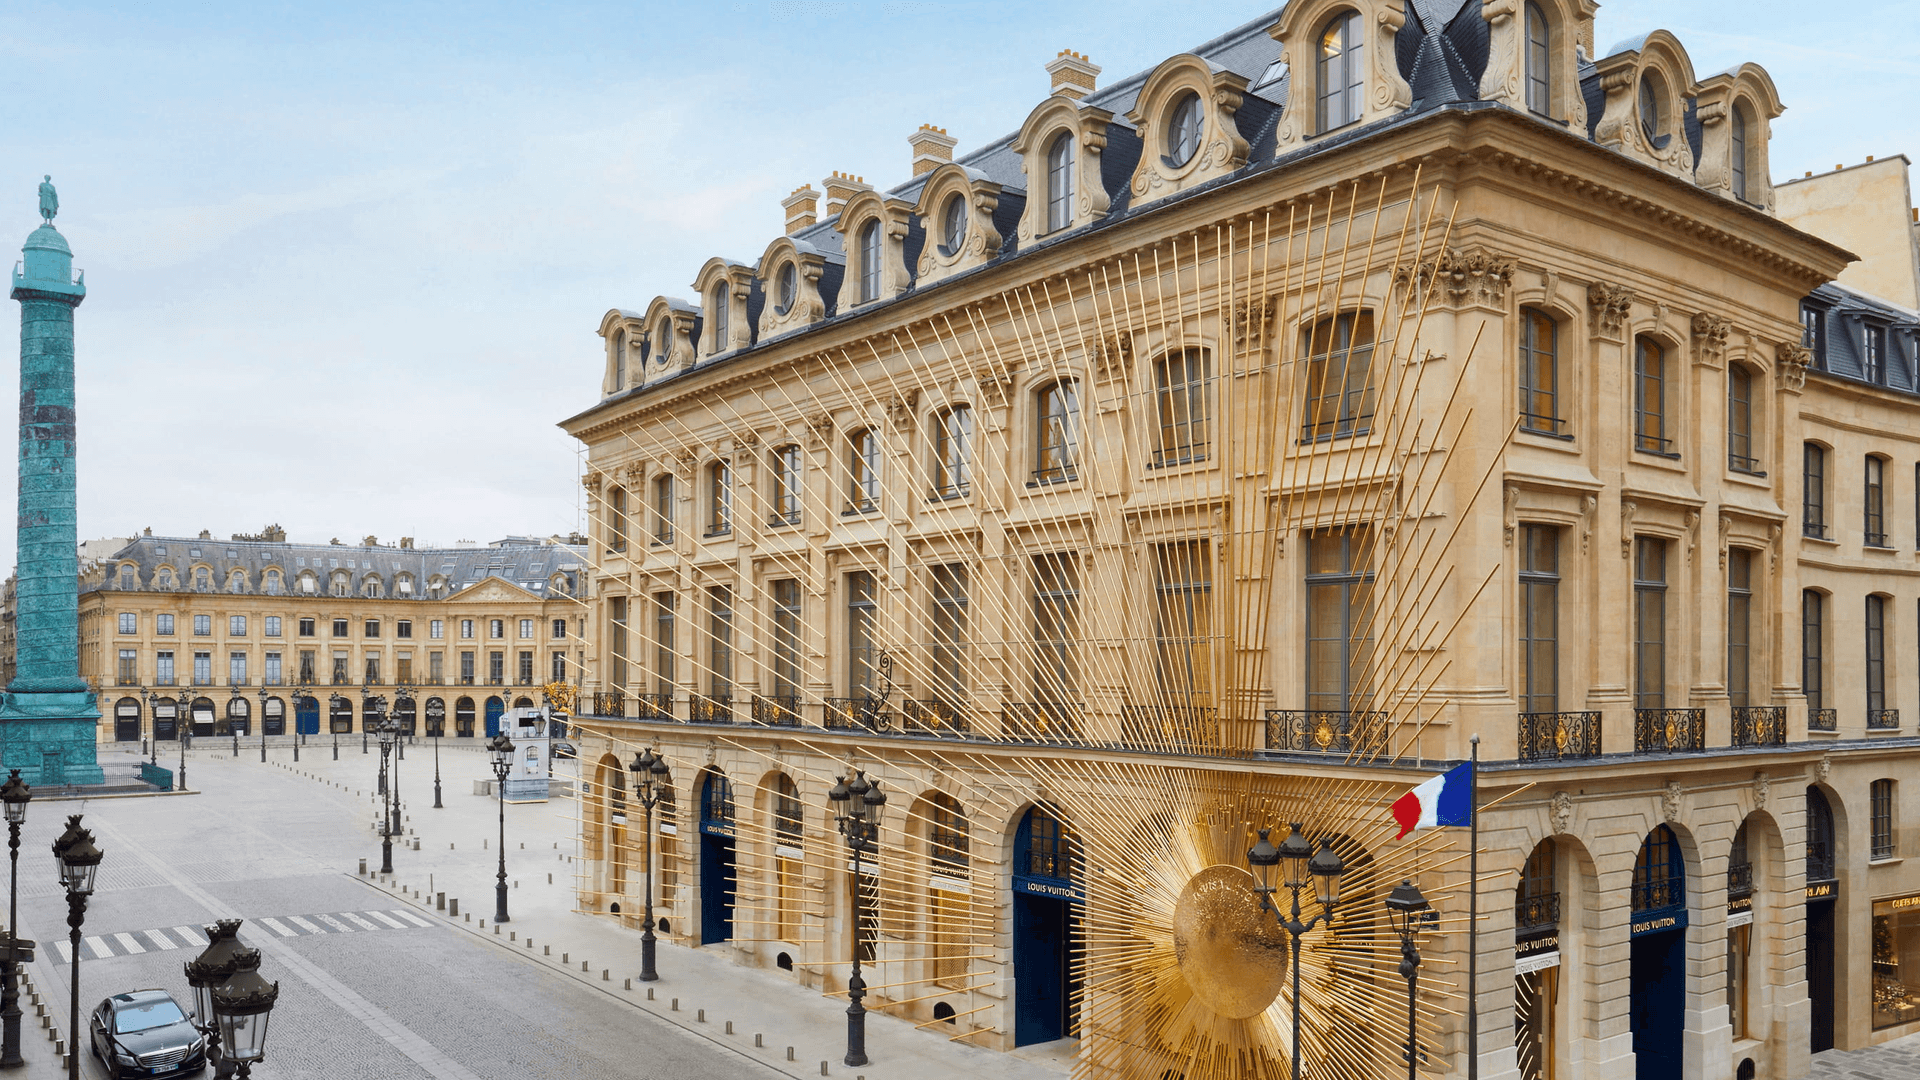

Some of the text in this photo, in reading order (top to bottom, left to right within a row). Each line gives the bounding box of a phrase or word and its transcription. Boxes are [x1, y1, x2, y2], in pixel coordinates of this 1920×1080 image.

[1028, 882, 1076, 897] LOUIS VUITTON
[1805, 885, 1830, 897] RLAIN
[1633, 917, 1676, 933] LOUIS VUITTON
[1515, 936, 1558, 953] OUIS VUITTON
